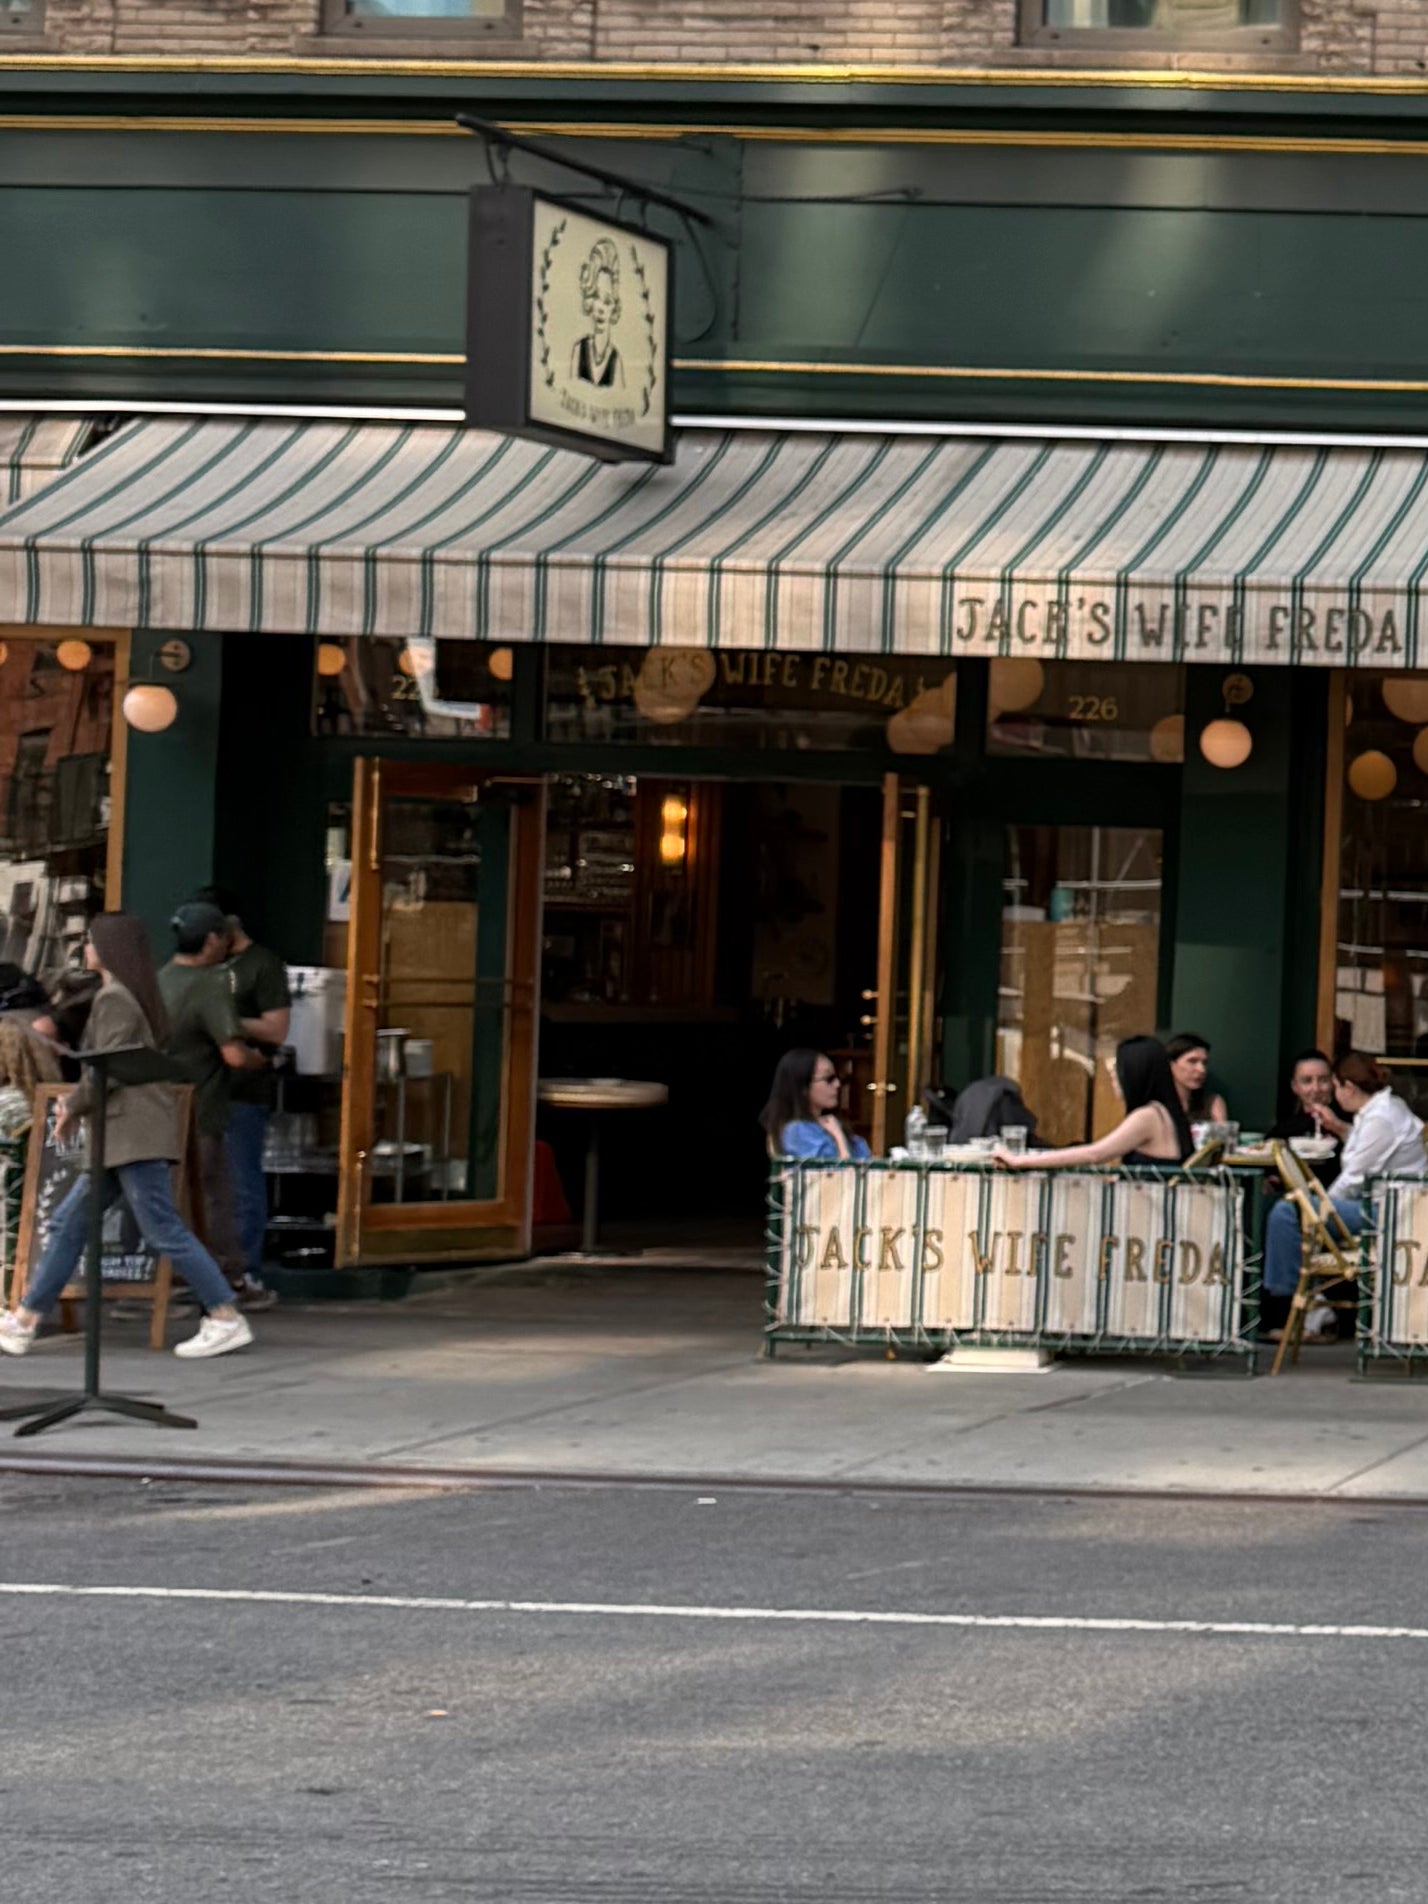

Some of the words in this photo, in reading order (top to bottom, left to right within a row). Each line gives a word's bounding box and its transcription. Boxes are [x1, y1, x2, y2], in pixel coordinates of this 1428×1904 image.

[956, 597, 1113, 646] JACK'S
[1134, 603, 1244, 650] WIFE
[1265, 606, 1403, 654] FREDA
[600, 651, 708, 700] JAK'S
[1069, 696, 1118, 720] 226
[795, 1223, 945, 1273] JACK'S
[1099, 1234, 1231, 1287] FREDA
